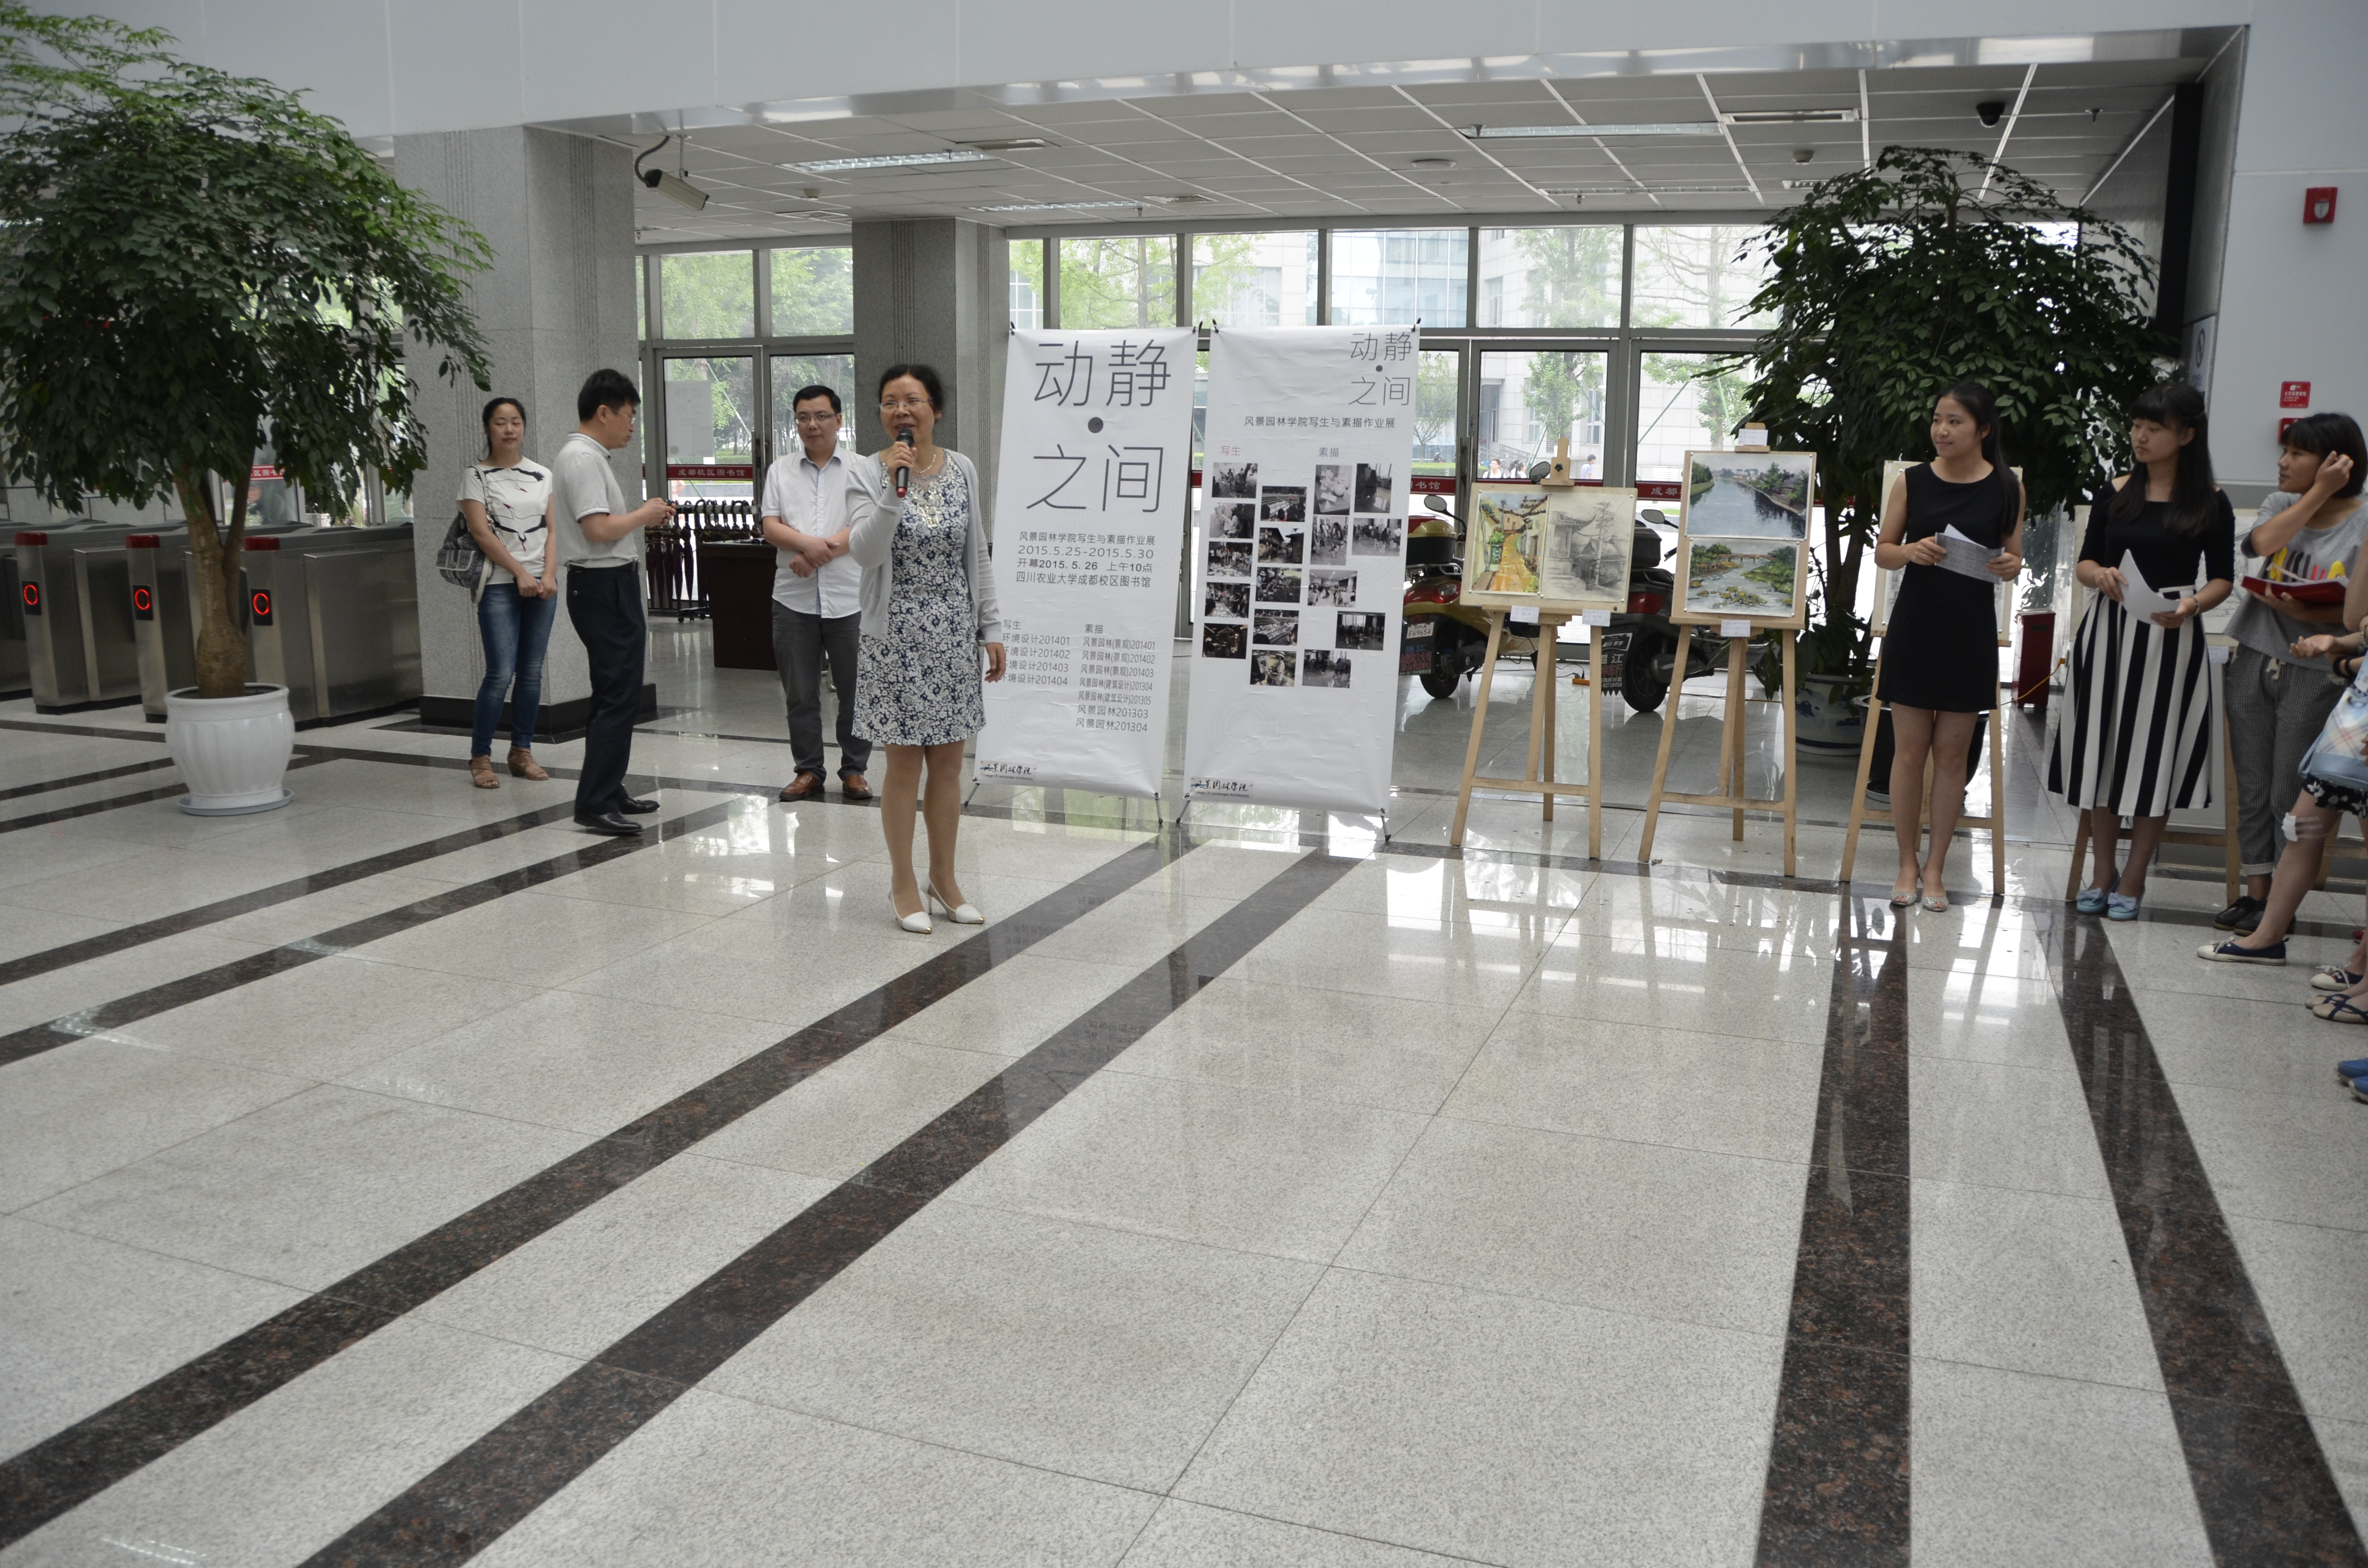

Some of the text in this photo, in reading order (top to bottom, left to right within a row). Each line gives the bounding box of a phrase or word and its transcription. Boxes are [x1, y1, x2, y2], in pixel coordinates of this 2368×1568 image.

[1350, 332, 1412, 361] 动静
[1034, 339, 1171, 406] 动静
[1349, 377, 1410, 406] 之间
[1245, 416, 1395, 428] 风景园林学院写生与素描作业展
[1221, 446, 1241, 456] 写生
[1319, 447, 1339, 457] 素描
[1026, 444, 1163, 513] 之间
[1651, 487, 1681, 496] 成都
[1019, 532, 1155, 546] 风景园林学院写生与素描作业展
[1018, 545, 1154, 559] 2015.5.25-2015.5.30
[1107, 561, 1153, 573] 上午10点
[1016, 572, 1151, 588] 四川农业大学成都校区图书馆
[1003, 620, 1021, 630] 写生
[1085, 624, 1103, 634] 素描
[1002, 633, 1070, 645] 环境设计201401
[1408, 629, 1431, 637] F69654
[1083, 637, 1155, 650] 风景园林(景观)201401
[1082, 651, 1155, 664] 风景园林(景观)201402
[1005, 660, 1068, 672] 境设计201403
[1081, 664, 1154, 677] 风景园林(景观)201403
[1080, 677, 1152, 691] 风景园林(建筑设计)201304
[1078, 691, 1151, 705] 风景园林(建筑设计)201305
[1077, 705, 1148, 718] 风景园林201303
[1076, 718, 1147, 732] 风景园林201304
